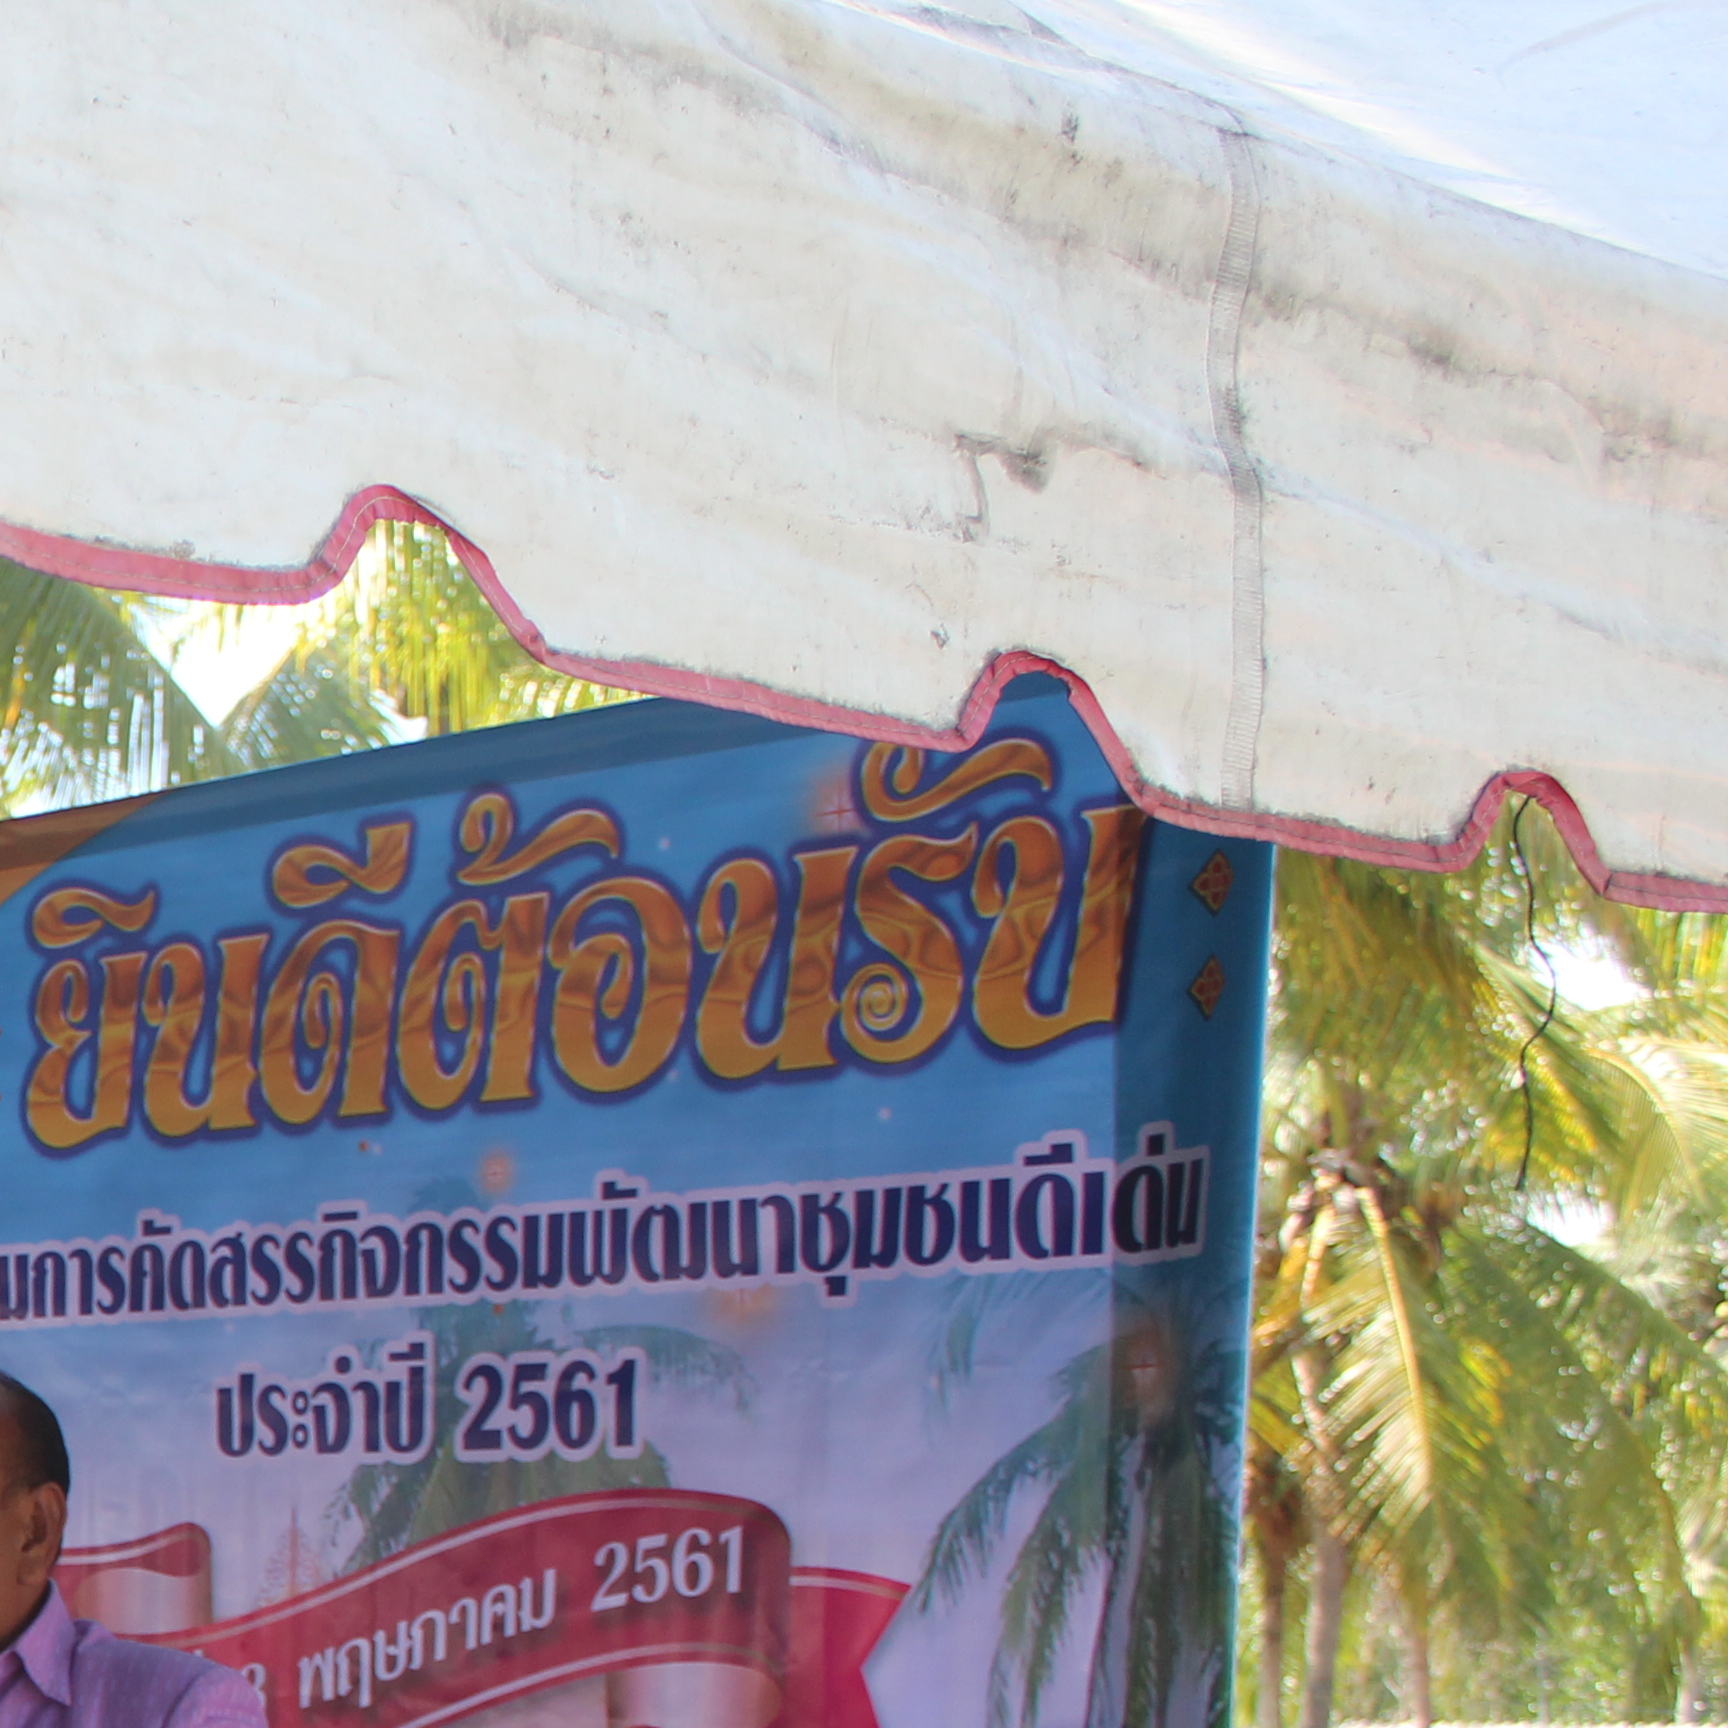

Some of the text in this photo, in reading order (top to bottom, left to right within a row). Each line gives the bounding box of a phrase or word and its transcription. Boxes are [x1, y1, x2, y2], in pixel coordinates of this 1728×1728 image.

[24, 735, 1146, 1152] ยินดีต้อนรับ
[215, 1341, 637, 1458] ประจำปี 2561
[297, 1568, 557, 1710] พฤษภาคม
[590, 1525, 746, 1614] 2561
